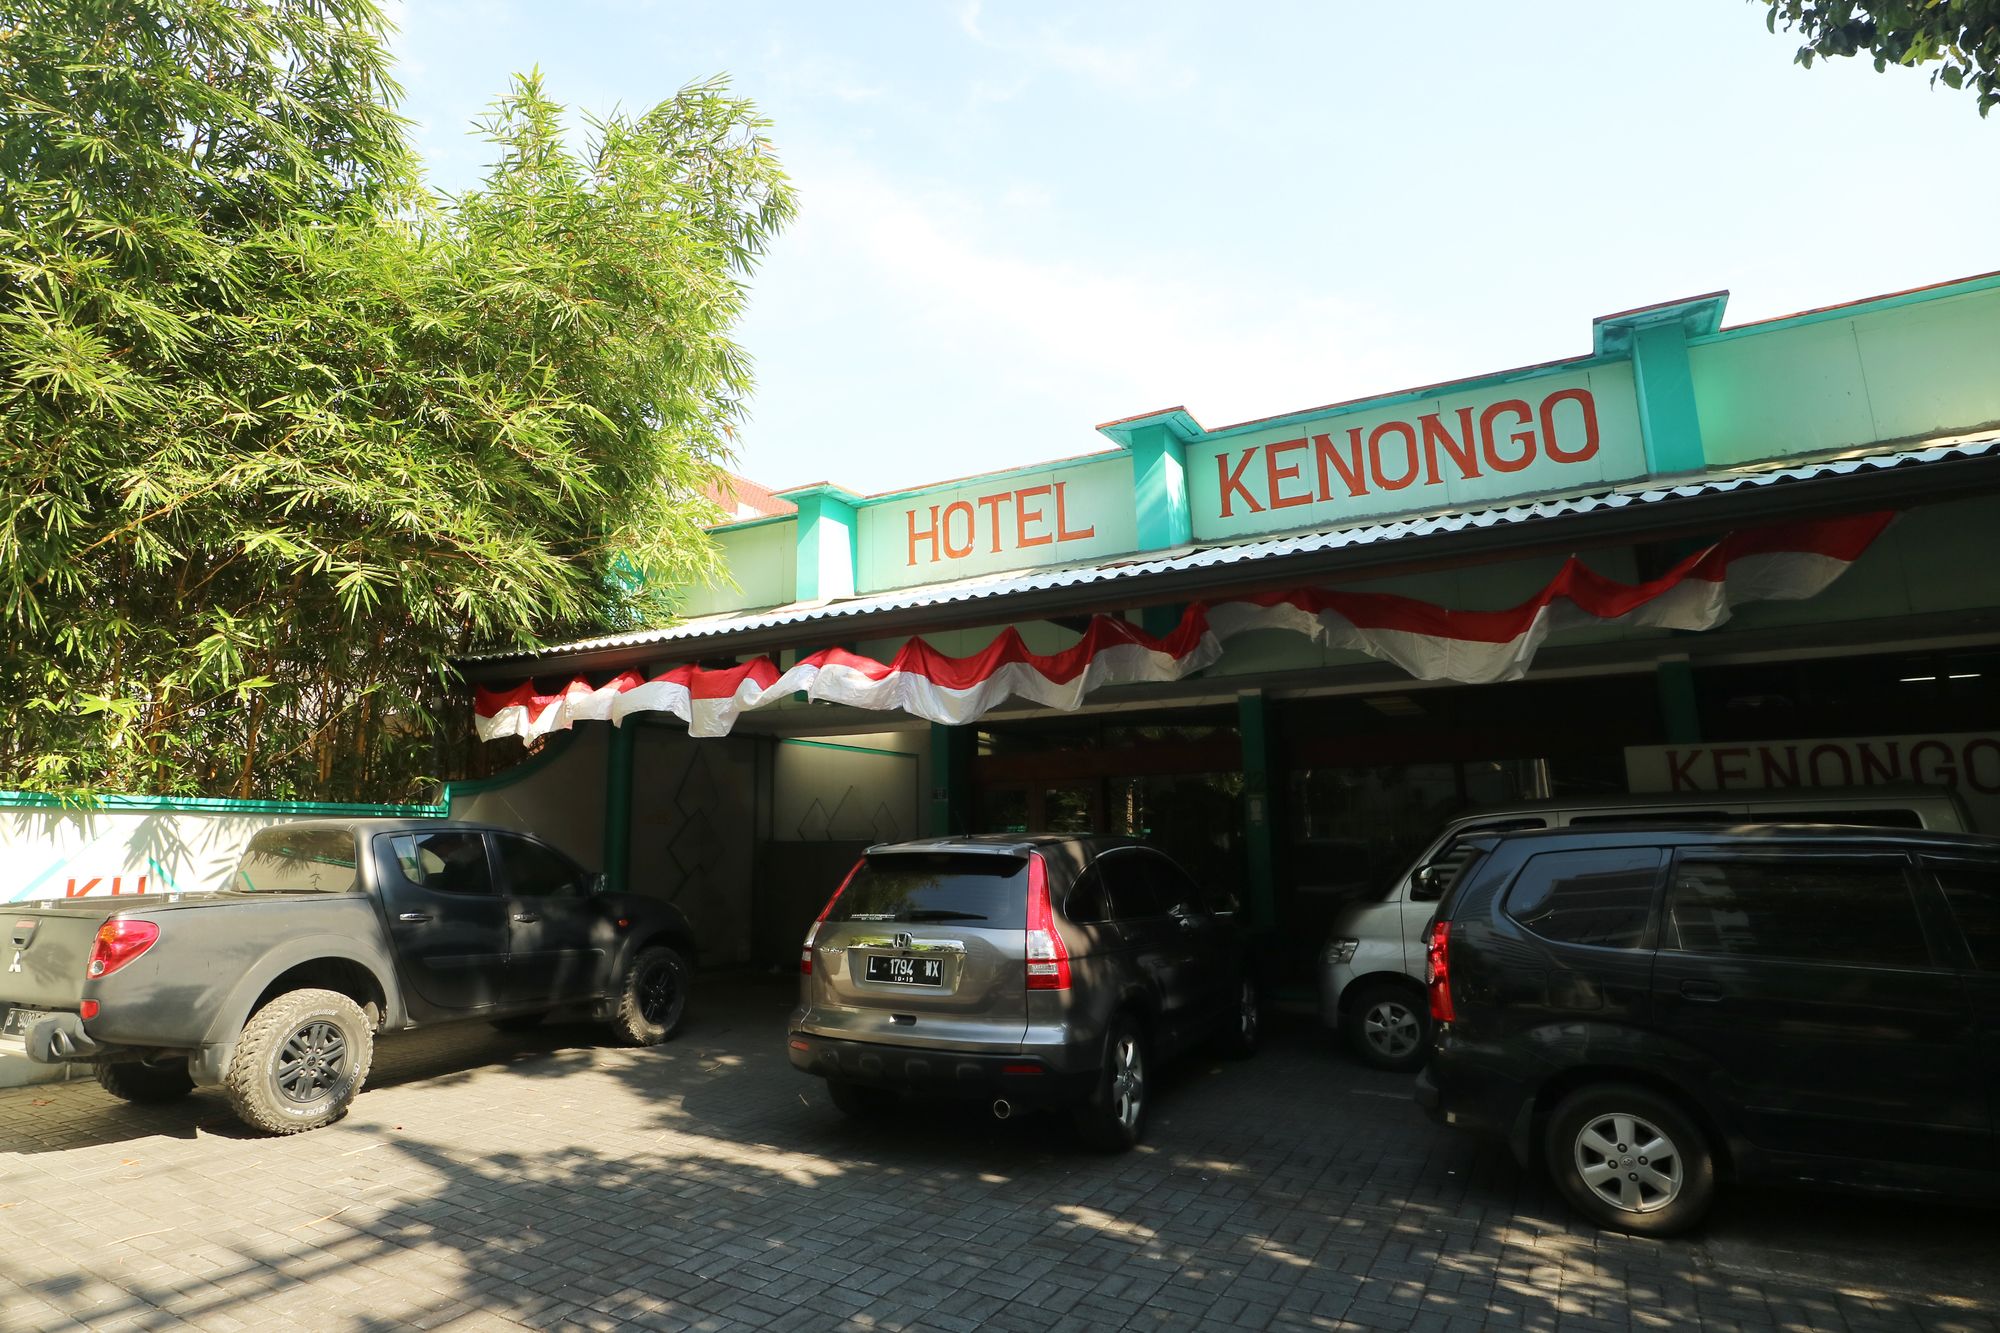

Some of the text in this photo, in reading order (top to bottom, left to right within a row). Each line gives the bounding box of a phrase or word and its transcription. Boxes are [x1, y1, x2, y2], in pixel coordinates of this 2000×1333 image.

[906, 388, 1600, 566] HOTEL KENONGO
[869, 957, 939, 977] L 1794 WX
